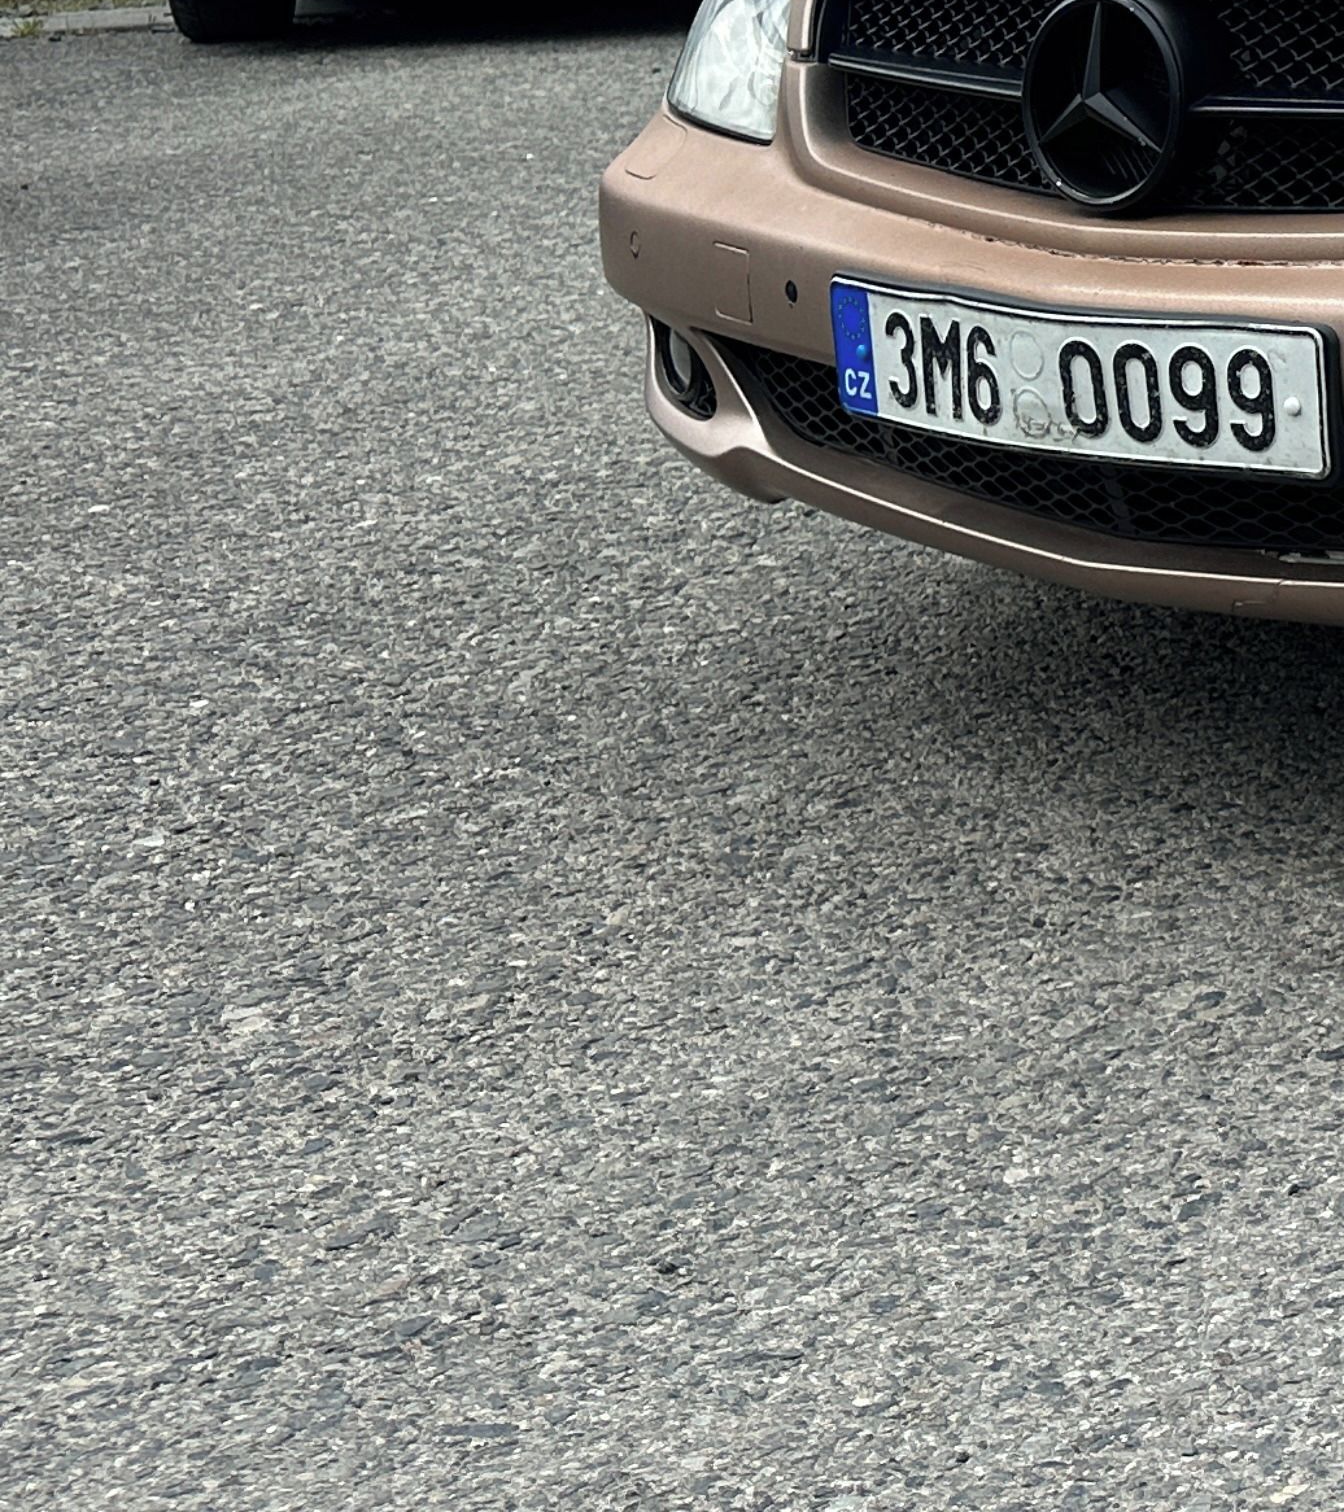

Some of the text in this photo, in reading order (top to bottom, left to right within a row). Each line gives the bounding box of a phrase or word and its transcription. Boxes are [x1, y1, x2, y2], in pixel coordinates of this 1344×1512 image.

[844, 368, 873, 400] CZ
[884, 310, 1277, 452] 3M6 0099
